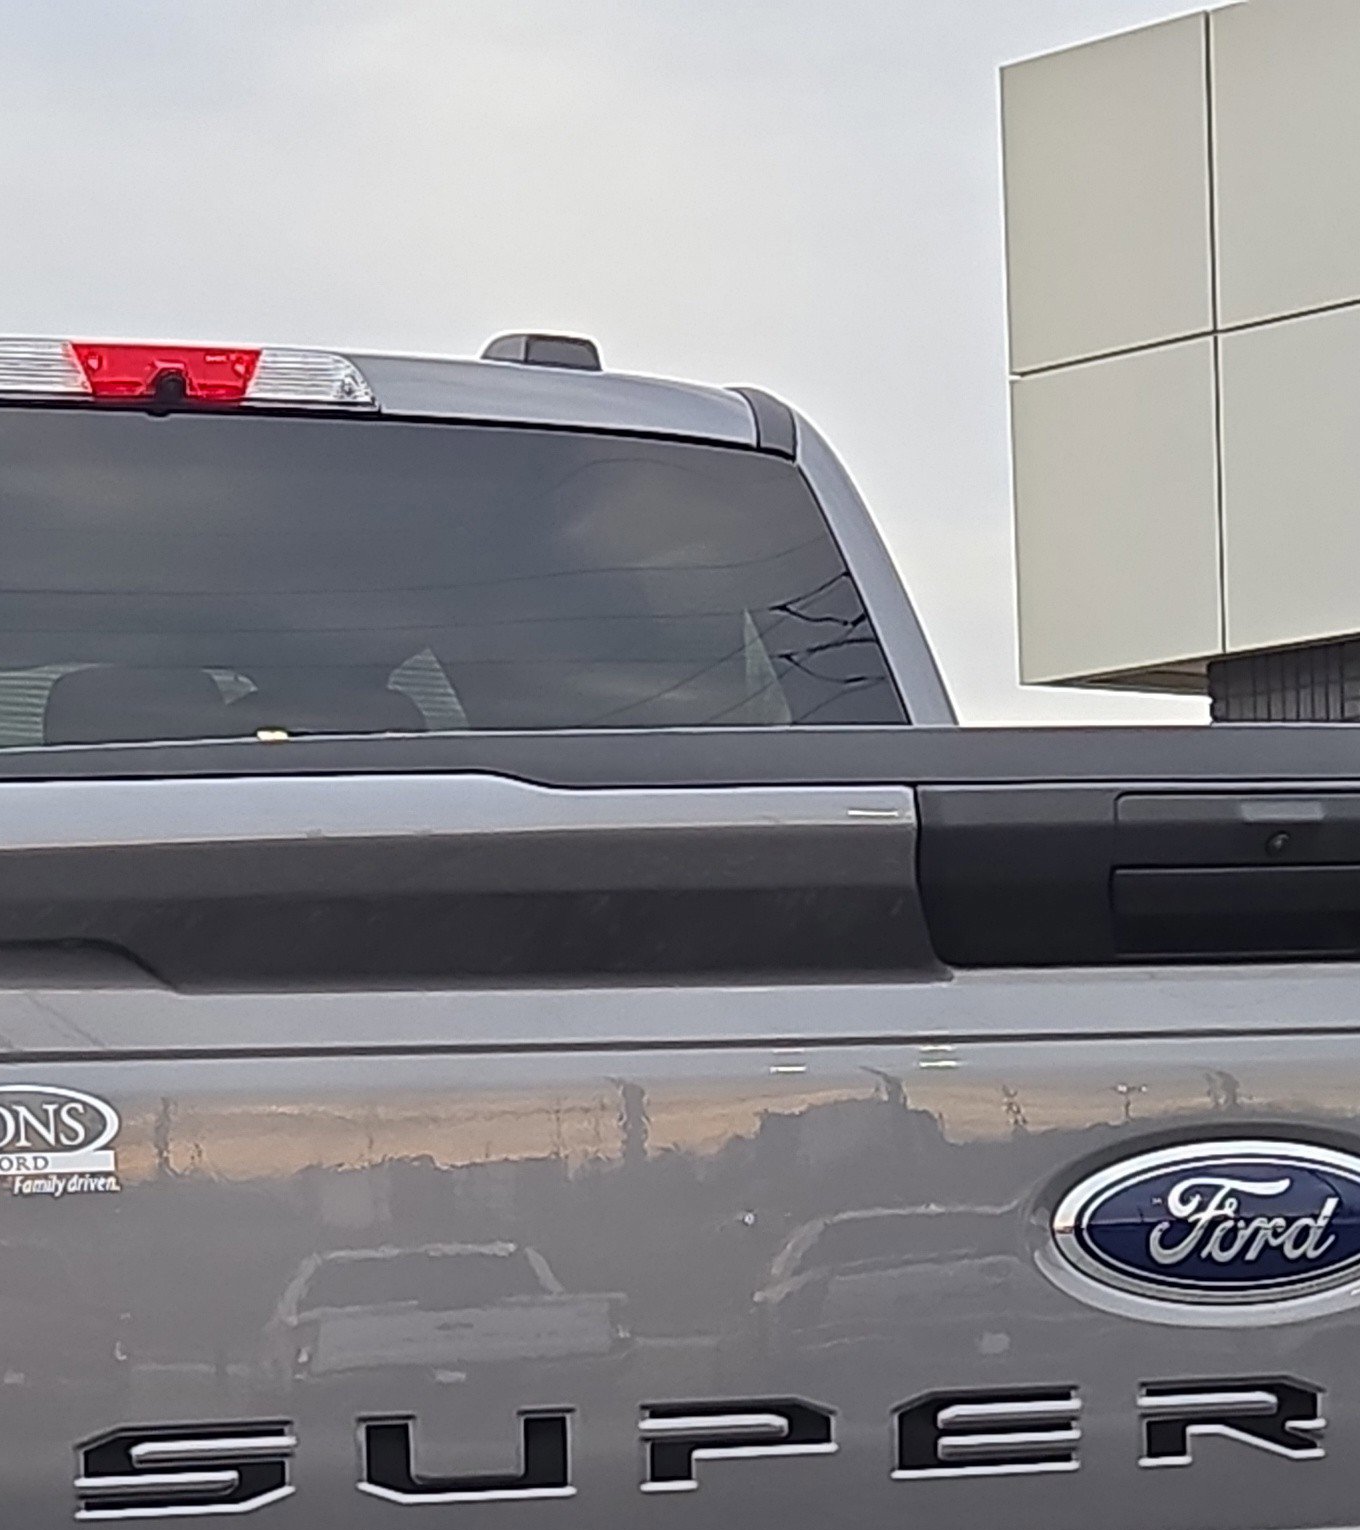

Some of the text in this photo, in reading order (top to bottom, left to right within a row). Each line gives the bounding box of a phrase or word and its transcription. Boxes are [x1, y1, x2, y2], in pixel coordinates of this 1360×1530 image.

[13, 1174, 67, 1197] Family
[1149, 1177, 1339, 1264] Ford
[73, 1375, 1326, 1520] SUPER
